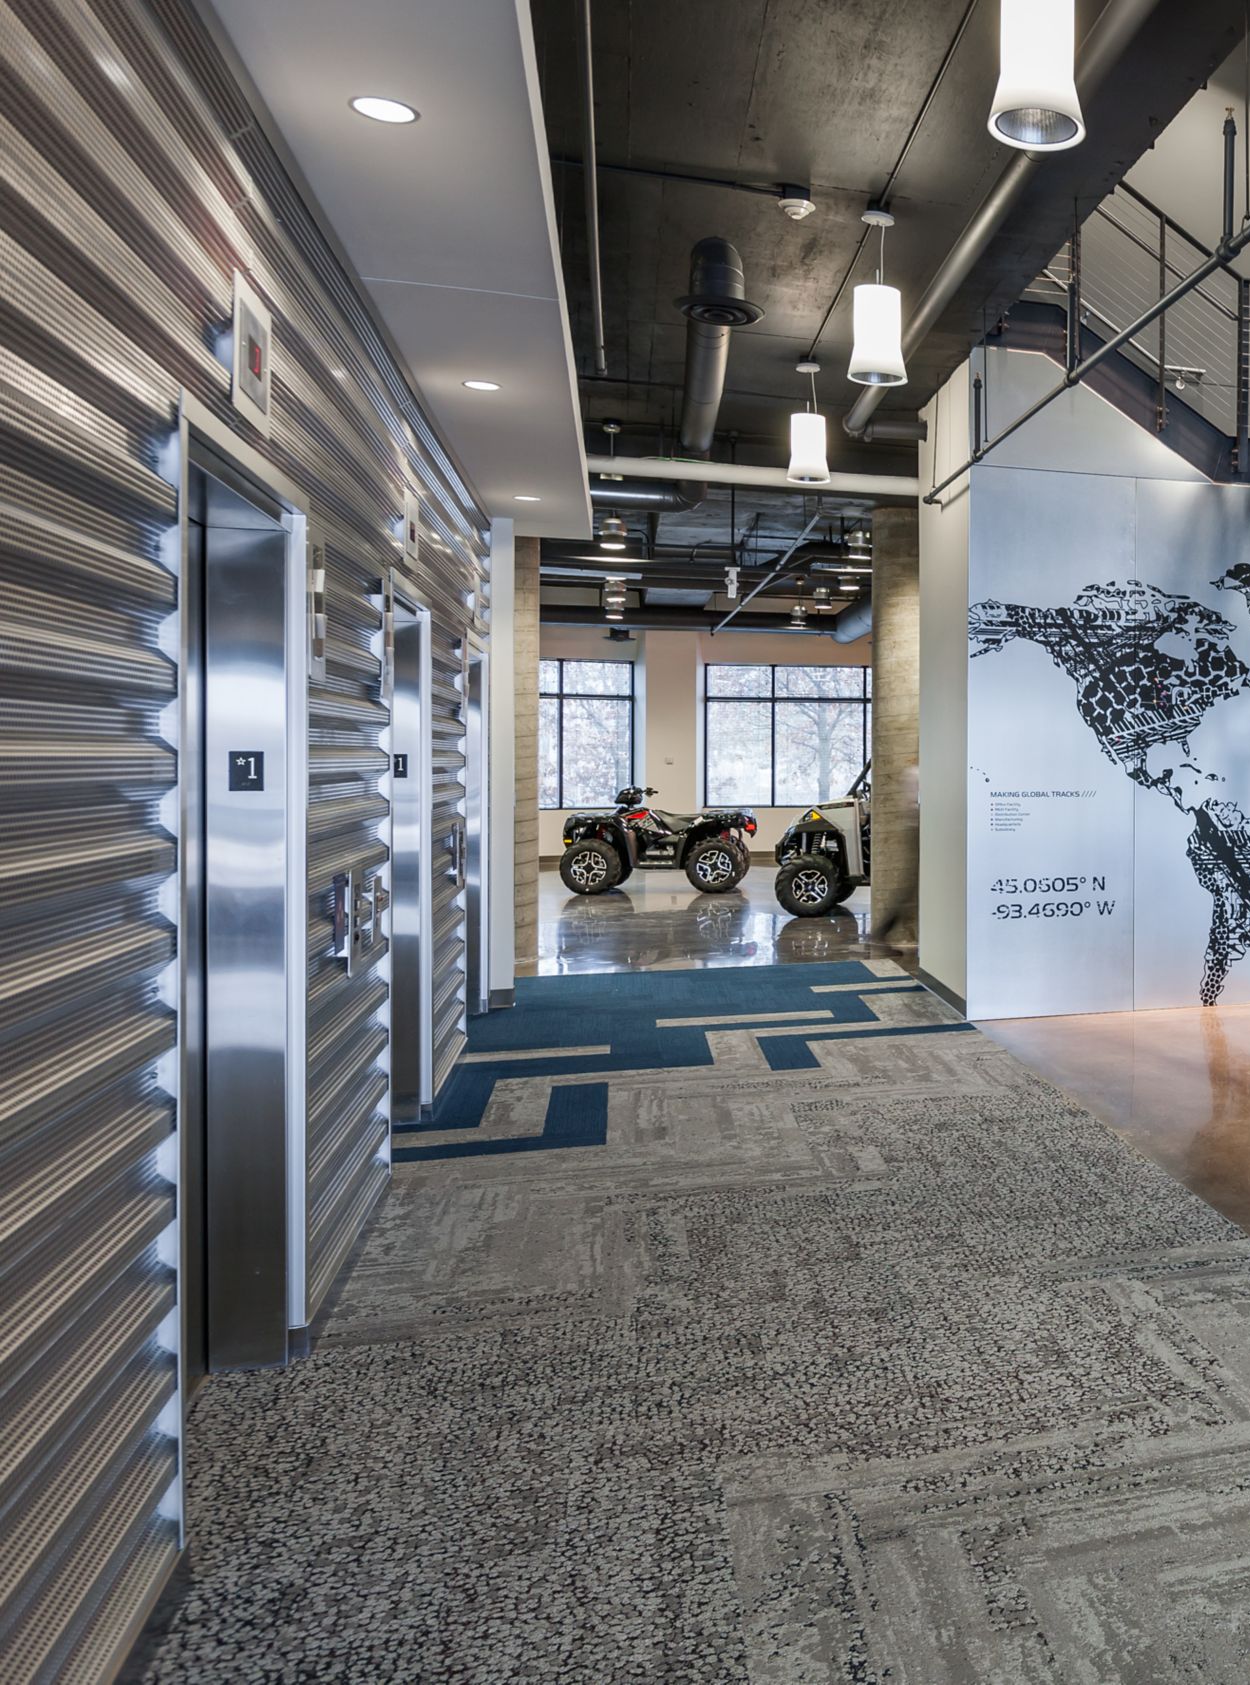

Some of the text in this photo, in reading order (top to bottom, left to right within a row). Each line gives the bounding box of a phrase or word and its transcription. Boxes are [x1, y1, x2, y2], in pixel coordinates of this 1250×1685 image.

[247, 757, 258, 779] 1
[397, 757, 404, 771] 1
[1051, 790, 1080, 798] TRACKS
[1092, 876, 1106, 891] N
[1096, 900, 1116, 916] W
